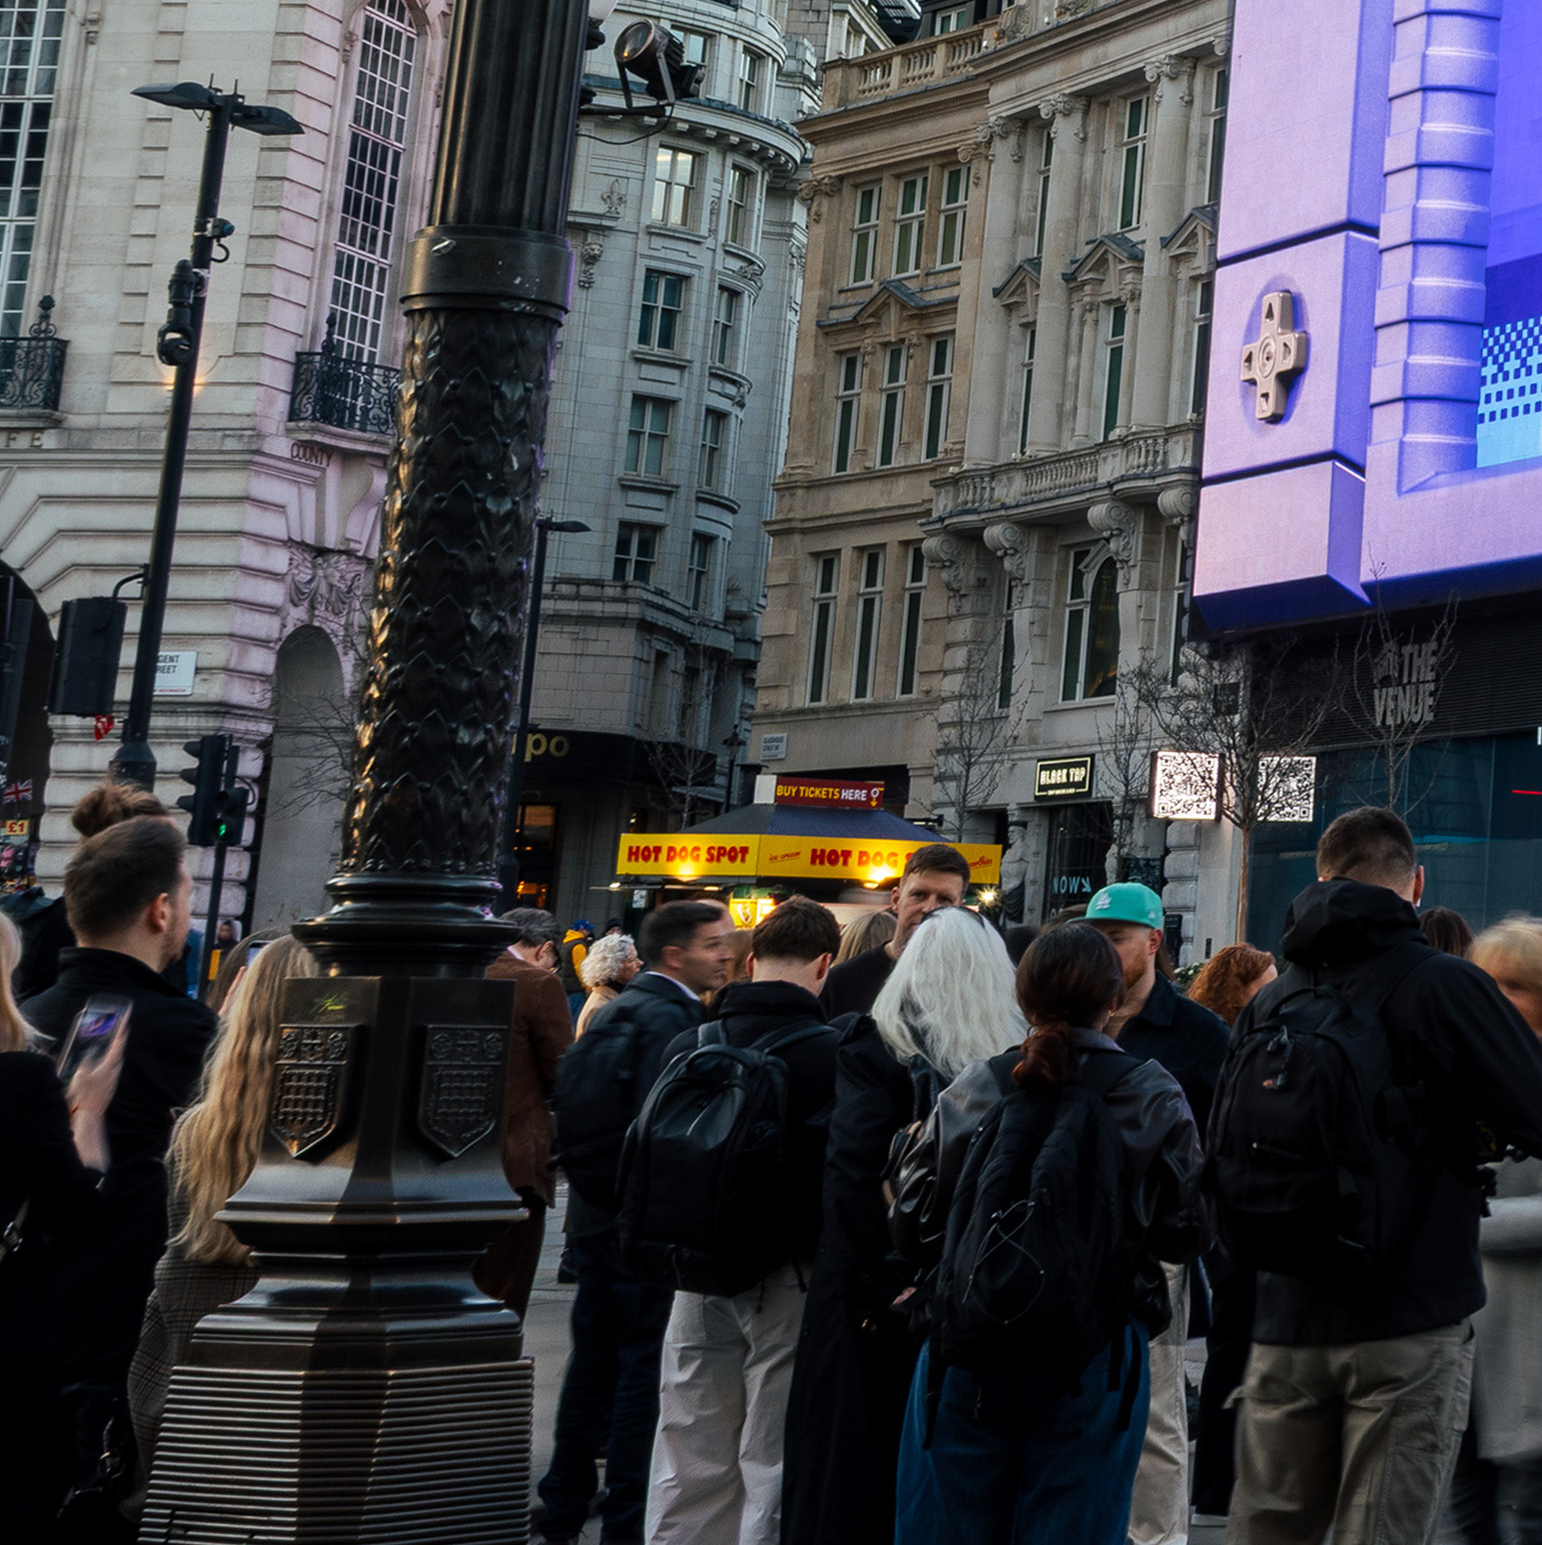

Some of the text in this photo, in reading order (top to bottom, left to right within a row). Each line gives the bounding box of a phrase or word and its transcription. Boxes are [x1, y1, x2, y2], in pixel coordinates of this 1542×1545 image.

[290, 441, 333, 467] COUNTY
[158, 655, 180, 664] GENT
[1401, 642, 1438, 684] THE
[157, 665, 177, 674] REET
[1374, 682, 1436, 726] VENUE
[511, 733, 569, 762] po
[777, 785, 867, 801] BUY TICKETS HERE
[8, 821, 25, 833] £1
[627, 846, 749, 864] HOT DOG SPOT
[810, 848, 852, 866] HOT
[857, 850, 899, 868] DOG
[1053, 876, 1080, 894] NOW
